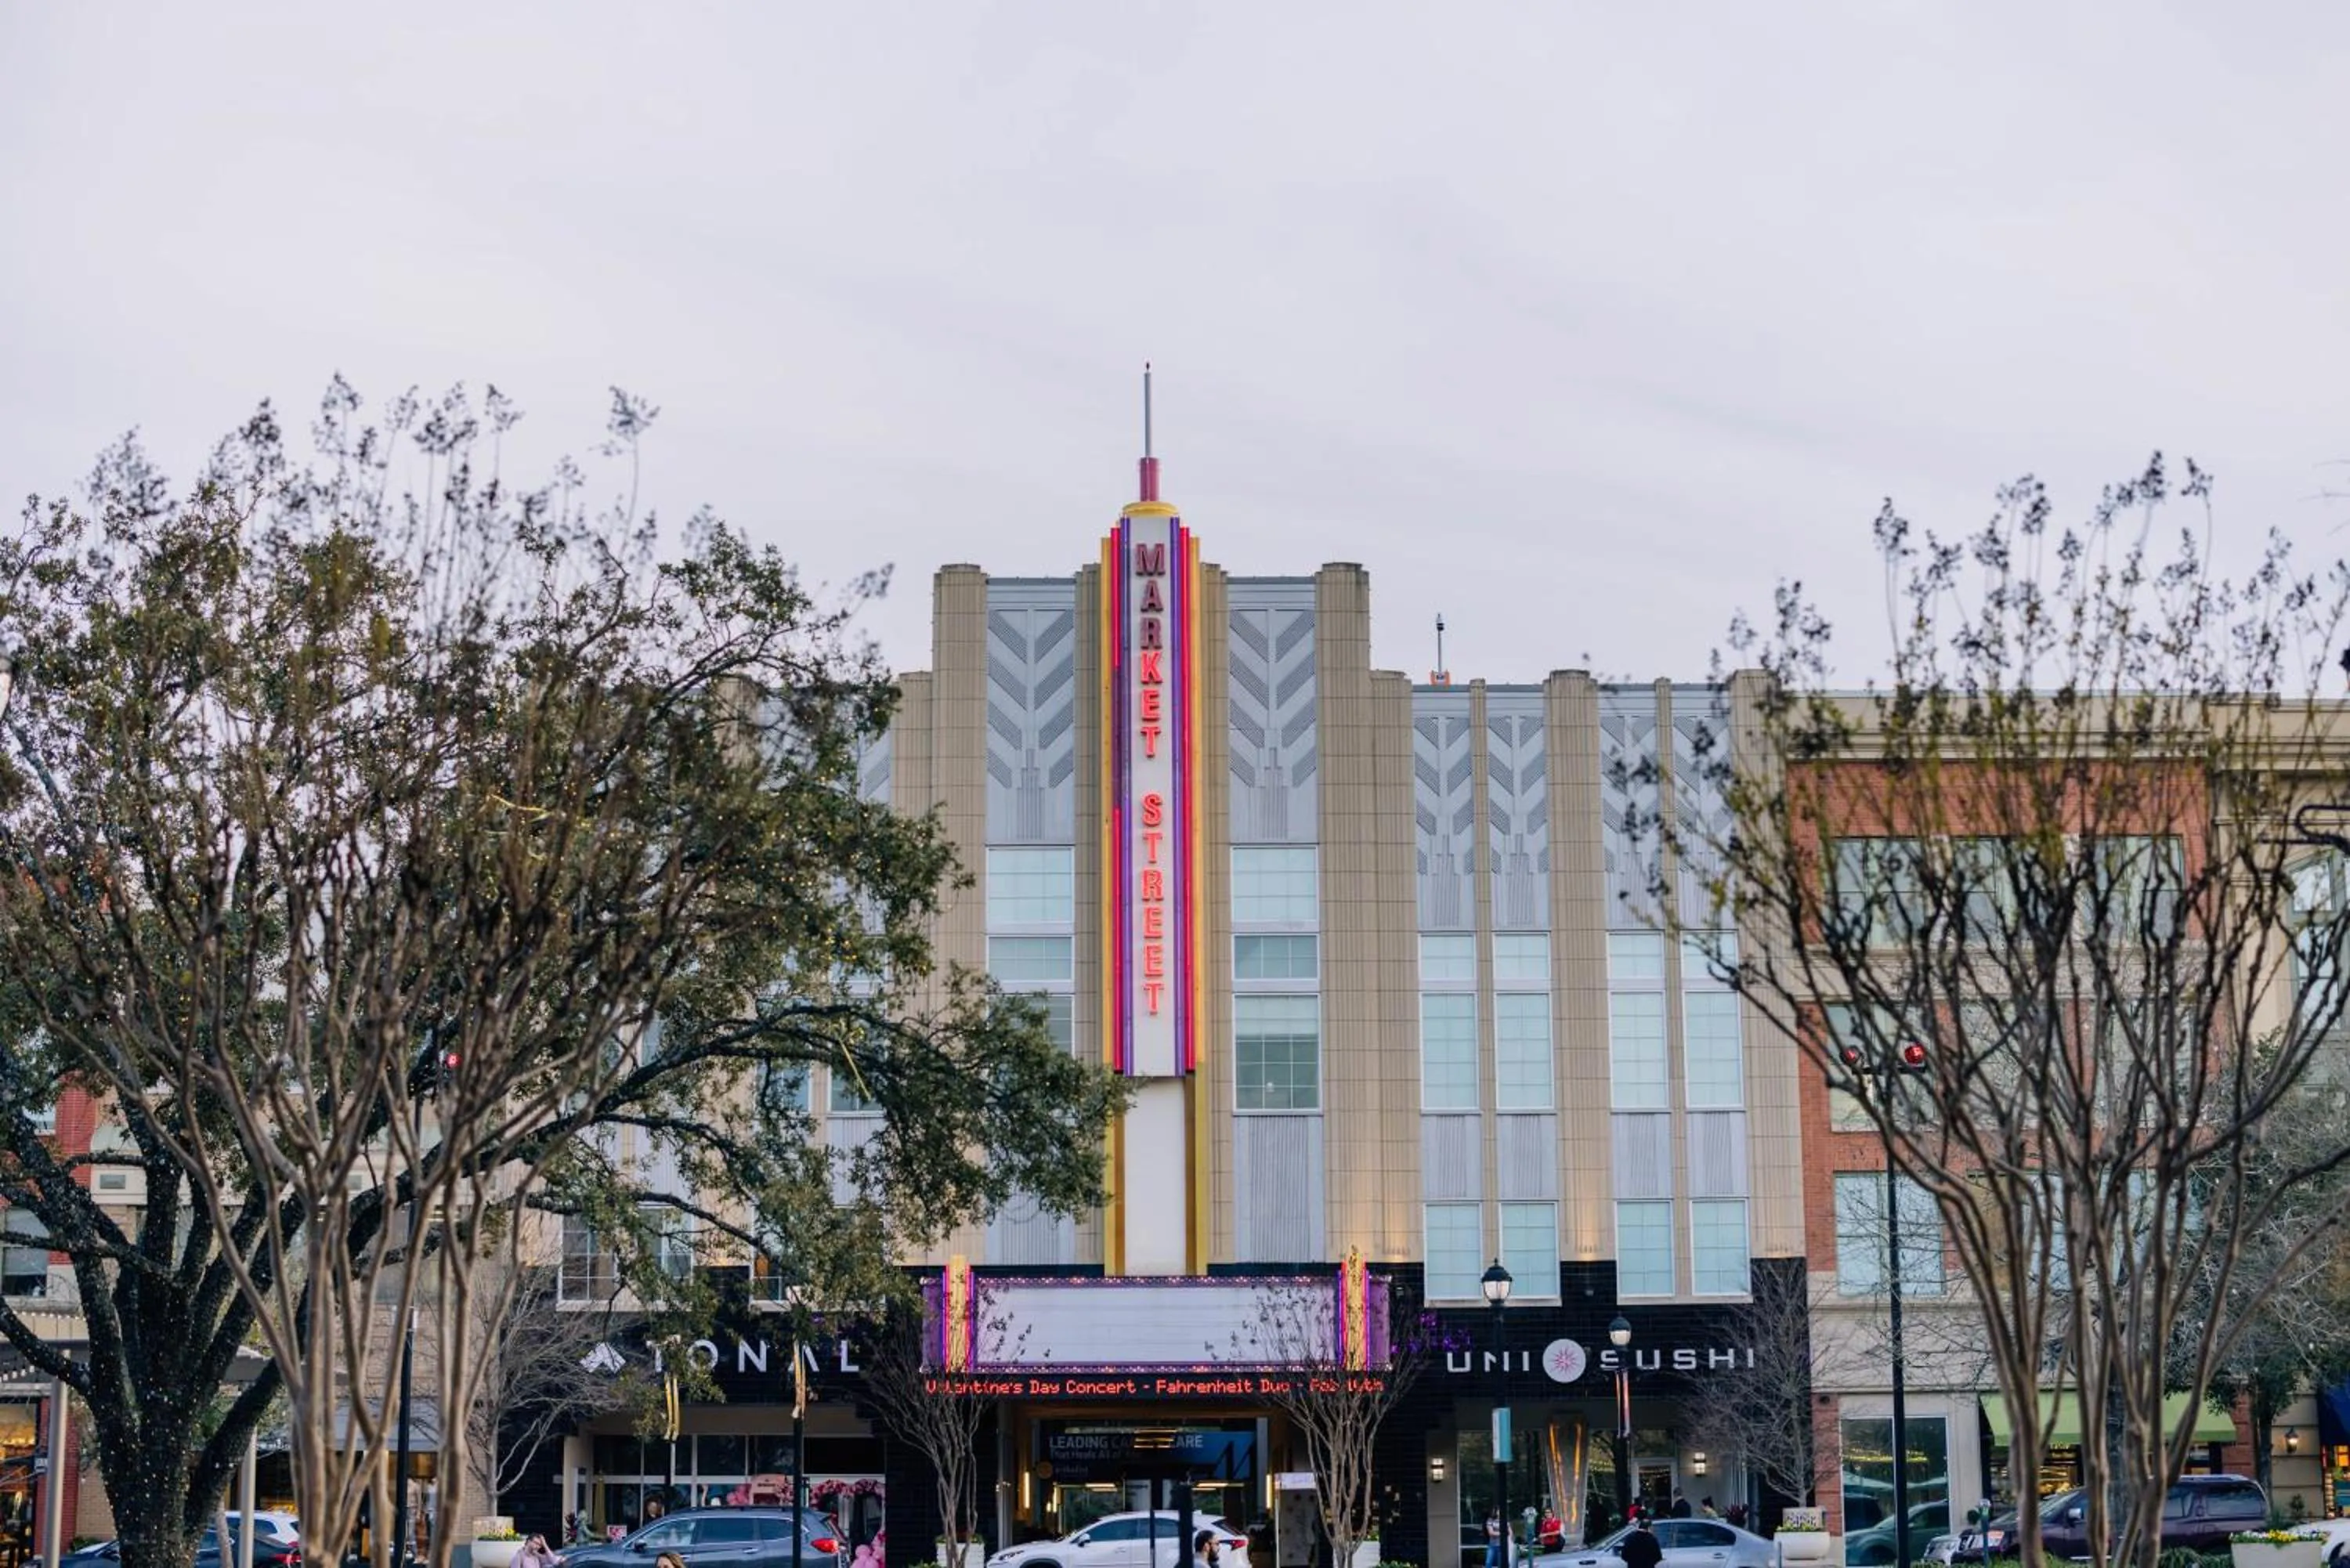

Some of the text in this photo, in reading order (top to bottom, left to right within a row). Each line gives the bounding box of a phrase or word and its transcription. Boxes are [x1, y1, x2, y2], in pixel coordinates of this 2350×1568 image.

[1135, 543, 1166, 1015] MARKET STREET
[1447, 1348, 1755, 1373] UNI SUSHI
[1029, 1379, 1060, 1394] Day
[1065, 1379, 1137, 1394] Concert
[1155, 1378, 1253, 1394] Fahrenheit
[1260, 1378, 1290, 1393] Duo
[1049, 1435, 1108, 1449] LEADING
[1167, 1434, 1204, 1449] ARE
